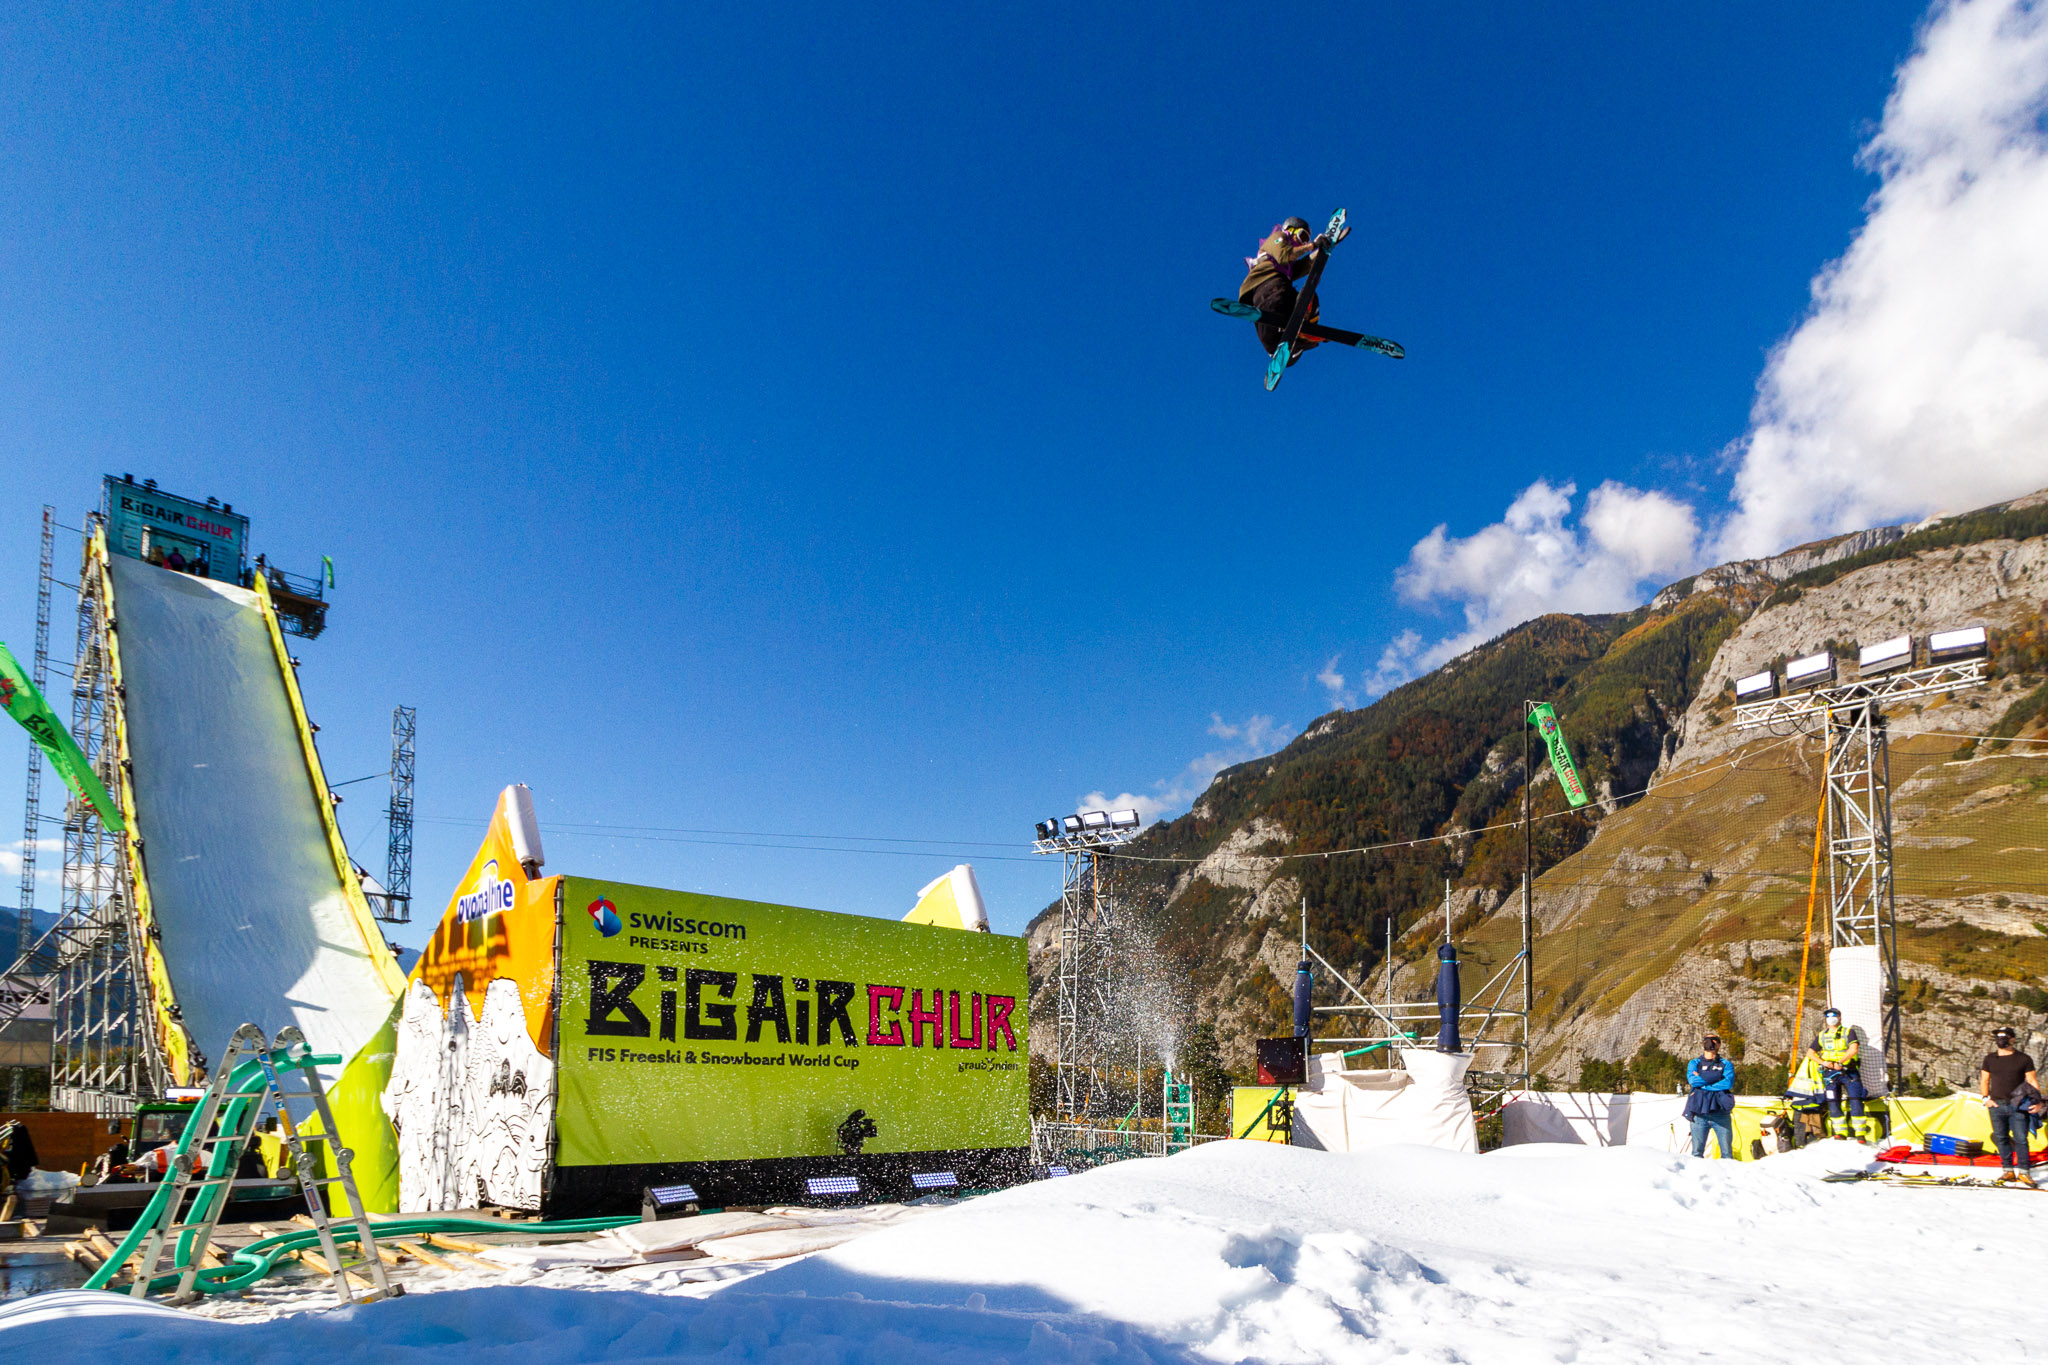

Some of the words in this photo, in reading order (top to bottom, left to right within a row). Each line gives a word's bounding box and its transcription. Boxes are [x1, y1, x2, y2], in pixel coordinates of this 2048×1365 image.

[459, 877, 513, 921] ovomaltine
[630, 911, 746, 939] swisscom
[630, 936, 708, 954] PRESENTS
[866, 984, 1017, 1052] CHUR
[588, 1048, 616, 1062] FIS
[620, 1049, 681, 1064] Freeski
[685, 1051, 698, 1064] &
[701, 1051, 785, 1066] Snowboard
[788, 1052, 831, 1067] World
[834, 1055, 860, 1070] Cup
